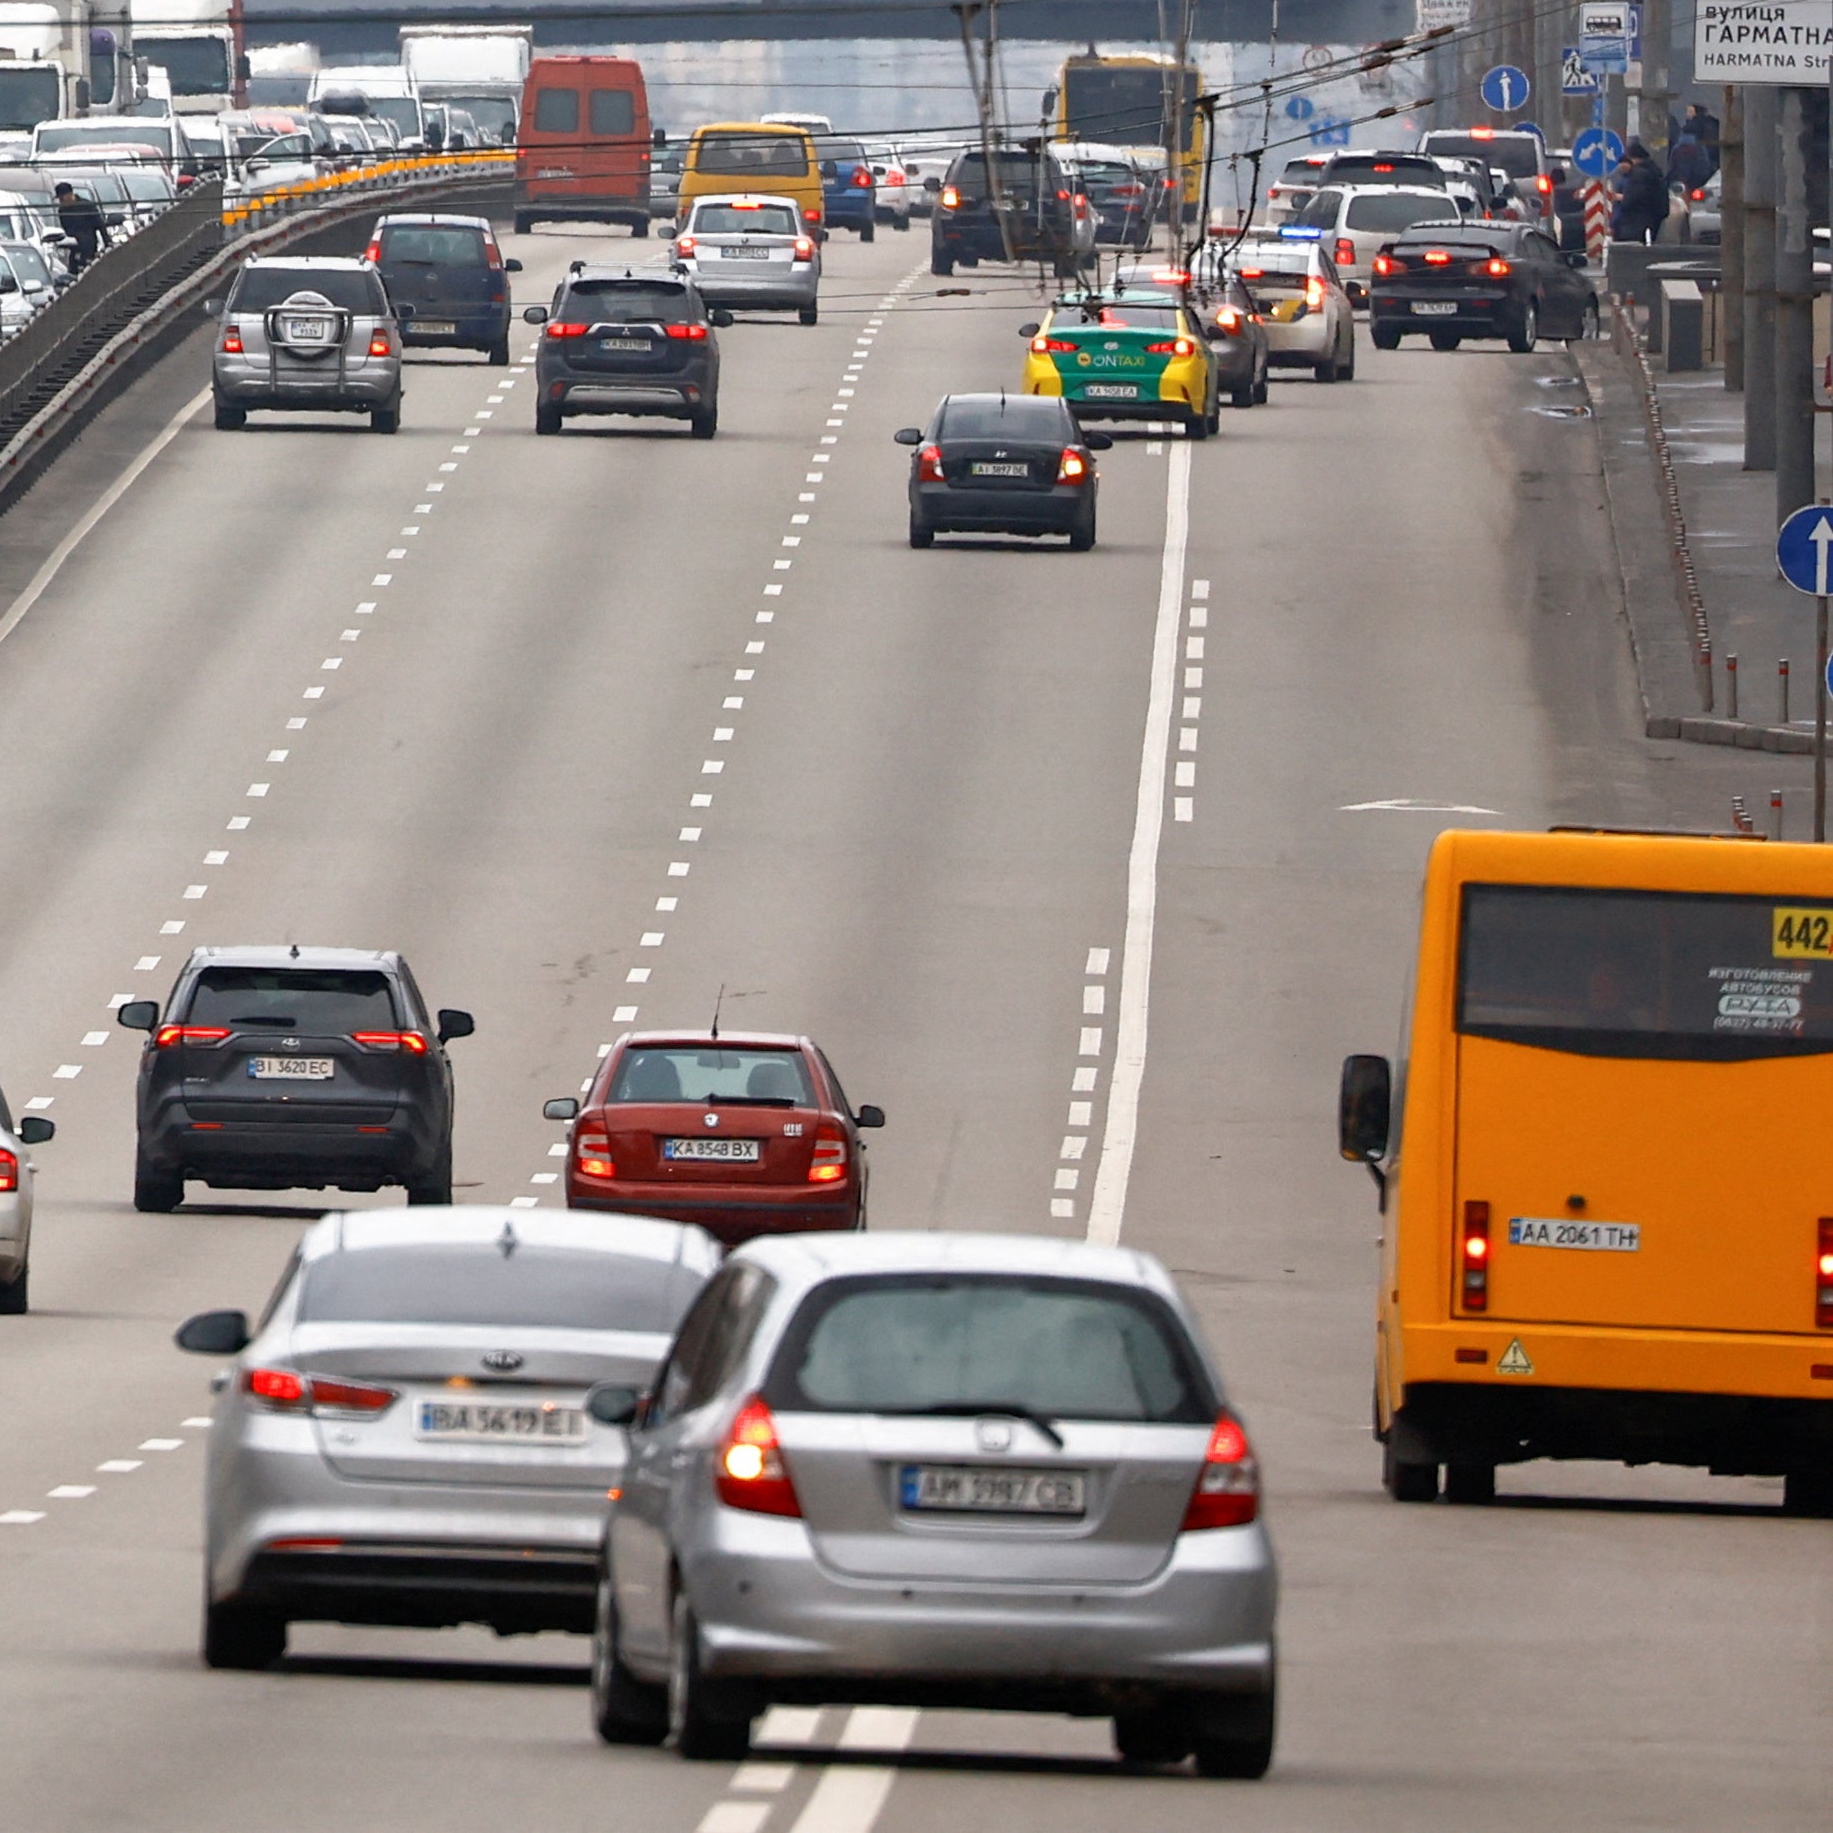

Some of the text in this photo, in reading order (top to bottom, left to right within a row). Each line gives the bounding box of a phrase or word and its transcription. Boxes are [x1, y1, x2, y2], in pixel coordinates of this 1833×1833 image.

[1706, 6, 1785, 24] вулиця
[1704, 53, 1796, 67] HARMATNA
[1777, 915, 1830, 951] 442
[1555, 1226, 1599, 1244] 2061
